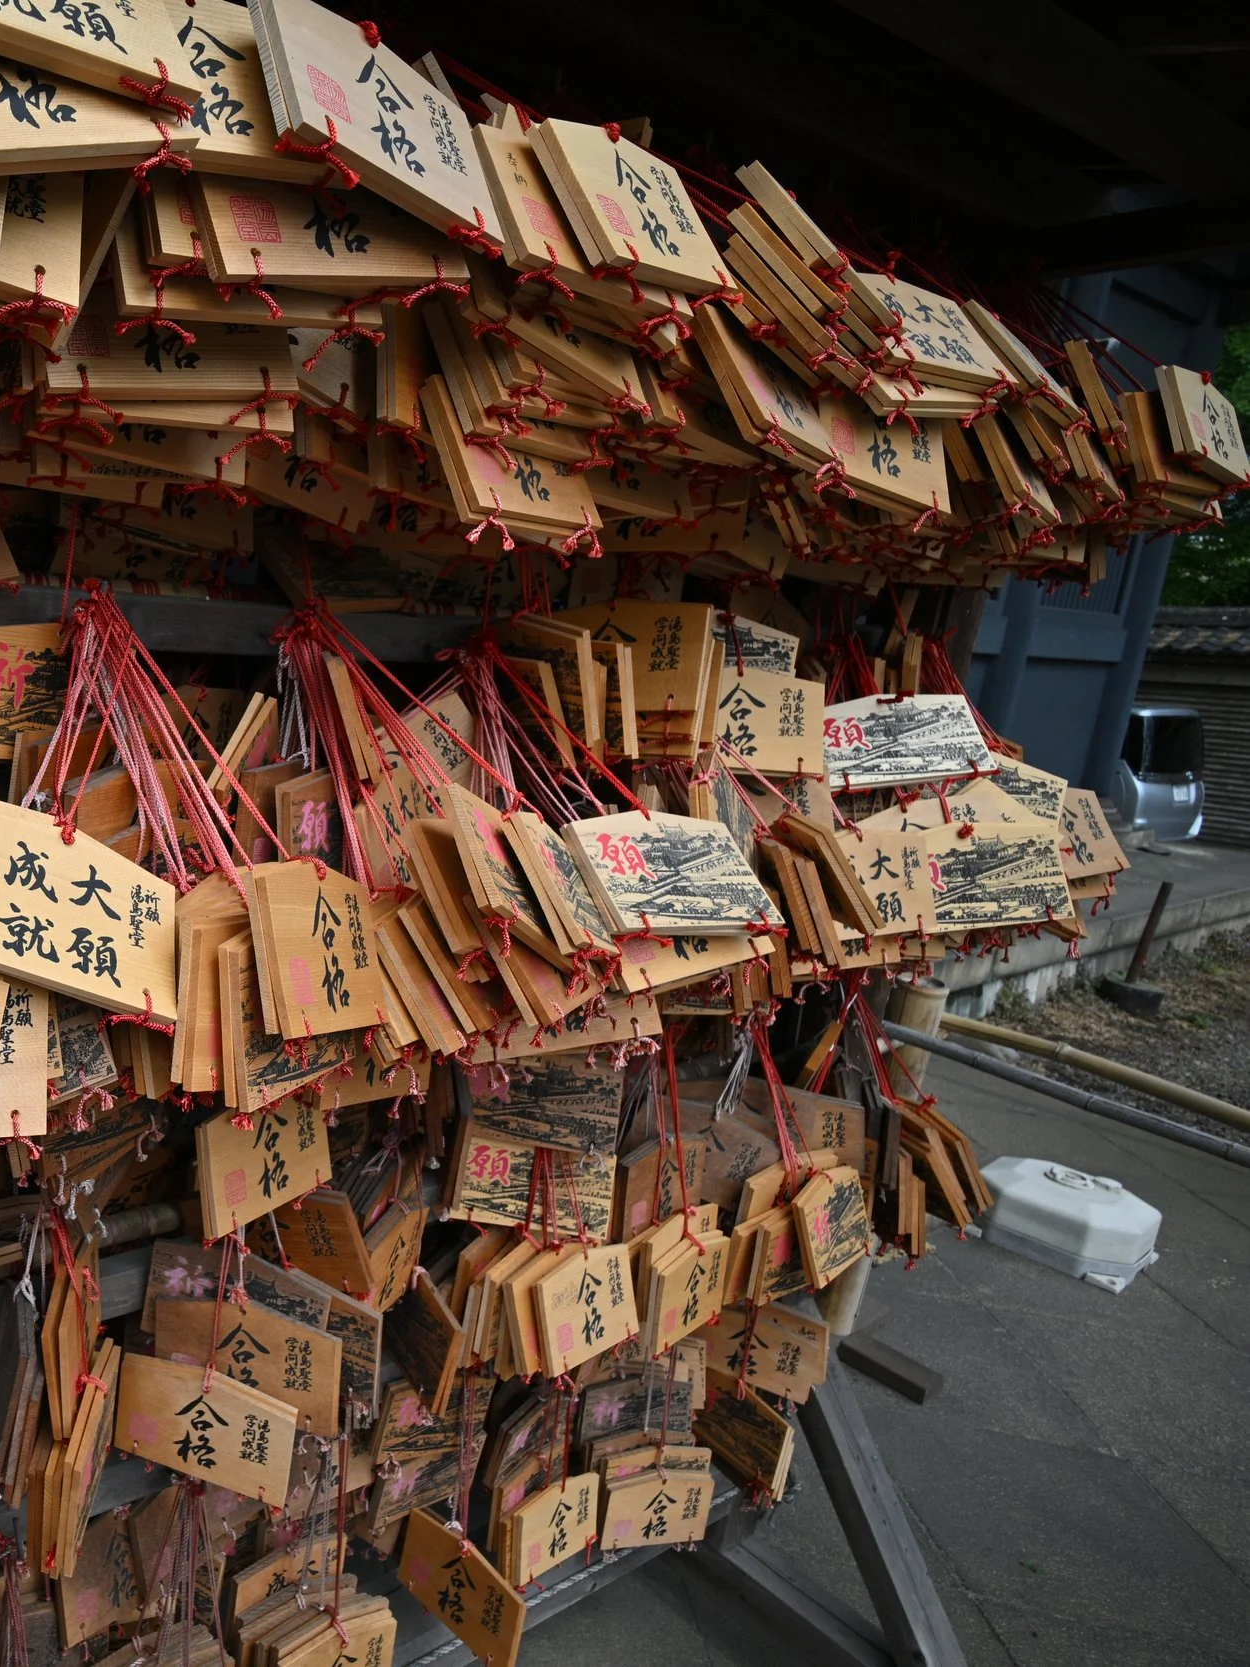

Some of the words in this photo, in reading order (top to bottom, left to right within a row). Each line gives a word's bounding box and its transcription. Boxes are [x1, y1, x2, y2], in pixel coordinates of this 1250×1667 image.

[178, 16, 255, 136] 合格
[356, 55, 426, 177] 合格
[438, 104, 468, 176] 湯島聖堂
[614, 148, 679, 257] 合格
[661, 169, 697, 235] 湯島聖堂
[913, 296, 984, 369] 大願
[1203, 391, 1229, 460] 合格
[648, 616, 666, 673] 学問成就
[666, 616, 683, 671] 湯島聖堂
[719, 682, 766, 758] 合格
[778, 688, 792, 737] 学問成就
[793, 689, 805, 737] 湯島聖堂
[823, 717, 872, 750] 願
[300, 800, 330, 852] 願
[1061, 805, 1095, 865] 合格
[595, 834, 657, 880] 願
[901, 846, 915, 891] 湯島聖堂
[910, 846, 921, 870] 祈願
[143, 892, 161, 926] 祈願
[870, 848, 907, 924] 大願
[67, 865, 122, 987] 大願
[130, 885, 146, 949] 湯島聖堂
[345, 893, 362, 972] 学問成就
[352, 893, 369, 969] 湯島聖堂
[313, 887, 350, 1014] 合格
[14, 987, 34, 1029] 祈願
[254, 1114, 289, 1199] 合格
[820, 1112, 834, 1149] 学問成就
[834, 1112, 847, 1149] 湯島聖堂
[468, 1143, 511, 1187] 願
[378, 1233, 406, 1308] 合格
[614, 1256, 625, 1303] 湯島聖堂
[682, 1260, 705, 1327] 合格
[577, 1267, 604, 1347] 合格
[283, 1337, 299, 1391] 学問成就
[298, 1340, 312, 1392] 湯島聖堂
[174, 1396, 229, 1469] 合格
[239, 1414, 257, 1462] 学問成就
[255, 1419, 270, 1466] 湯島聖堂
[548, 1500, 573, 1558] 合格
[640, 1489, 678, 1540] 合格
[682, 1487, 695, 1520] 学問成就
[690, 1487, 701, 1519] 湯島聖堂
[102, 1528, 138, 1609] 合格
[438, 1556, 476, 1625] 合格
[491, 1593, 504, 1638] 湯島聖堂
